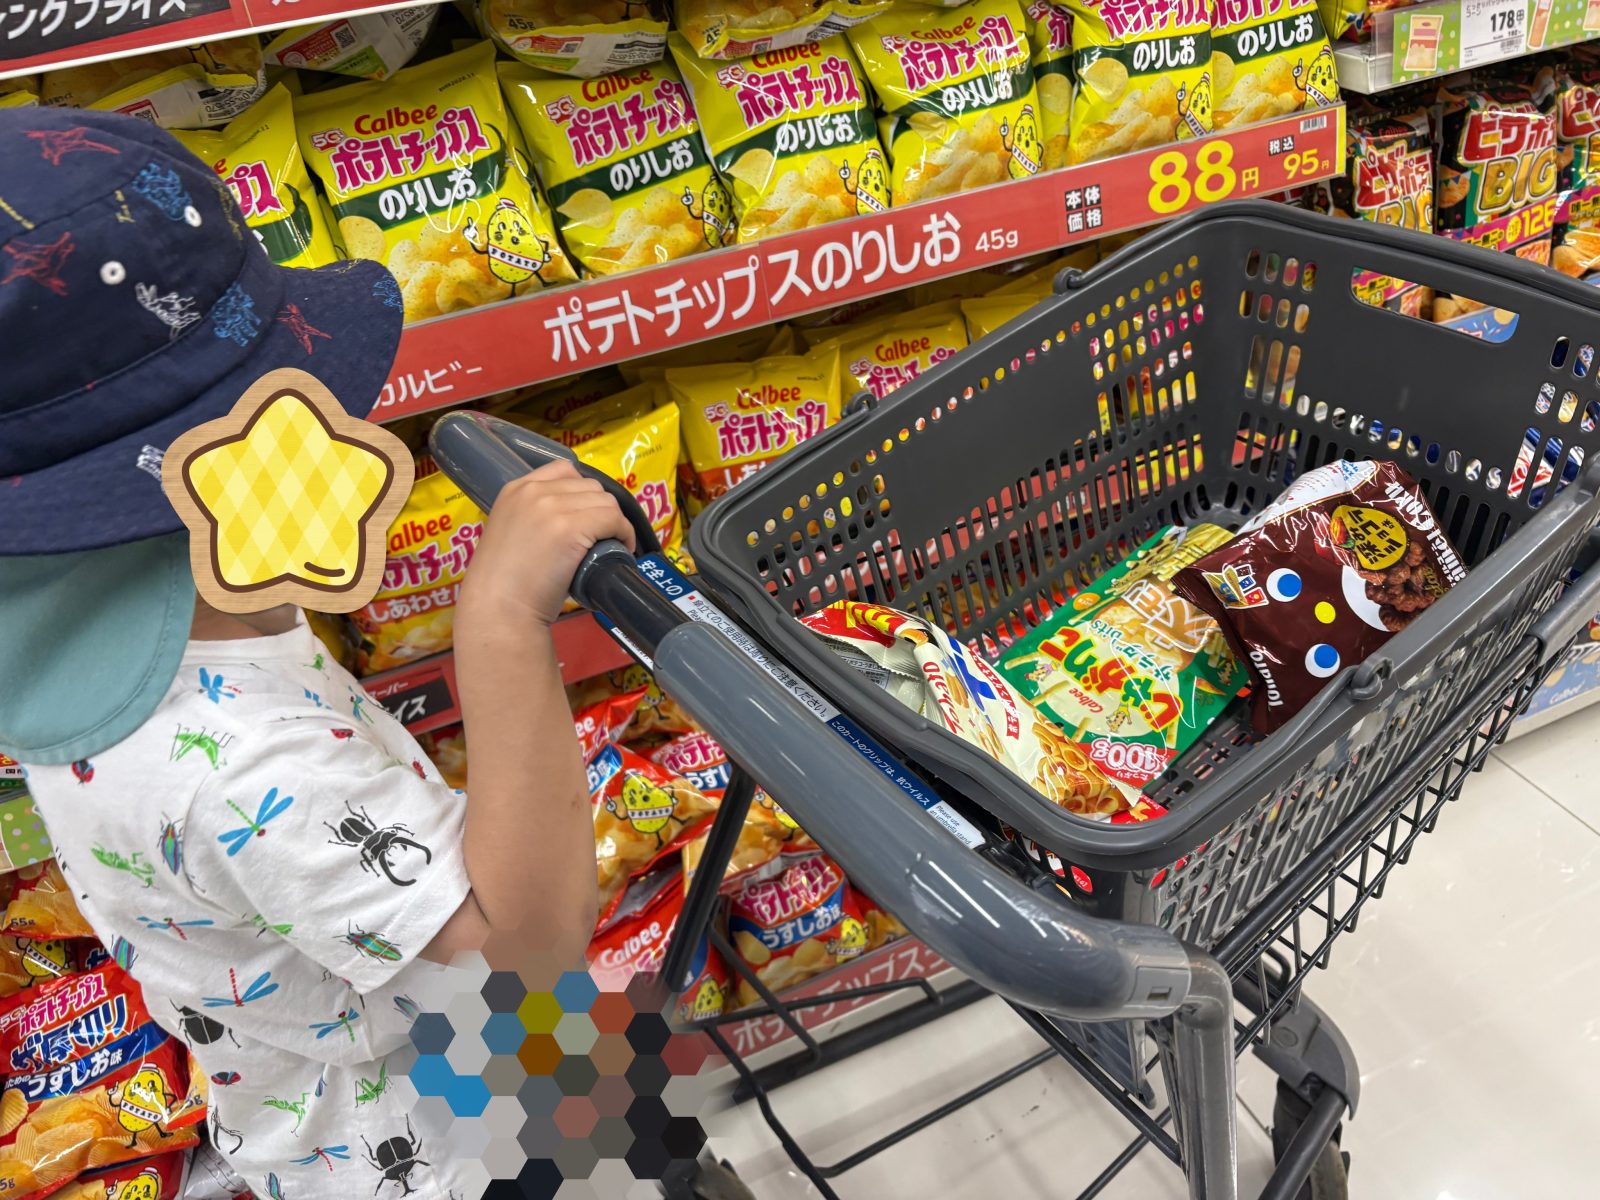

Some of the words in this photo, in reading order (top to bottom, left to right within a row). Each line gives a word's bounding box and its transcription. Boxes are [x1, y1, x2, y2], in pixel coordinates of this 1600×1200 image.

[706, 24, 722, 46] 45
[911, 16, 976, 41] Calbee
[1237, 13, 1314, 57] のりしお
[900, 15, 1020, 93] ポテトチップス
[1132, 36, 1196, 72] のりしお
[736, 56, 862, 130] ポテトチップス
[943, 69, 1014, 112] のりしお
[355, 104, 438, 136] Calbee
[566, 79, 698, 168] ポテトチップス
[776, 114, 856, 153] のりしお
[330, 105, 491, 193] ポテトチップス
[1269, 135, 1295, 155] 税込
[610, 139, 694, 192] のりしお
[1477, 144, 1556, 212] BIG
[378, 168, 478, 221] のりしお
[1066, 186, 1101, 210] 本体
[1067, 208, 1102, 233] 価格
[491, 247, 538, 270] POTATO
[543, 212, 962, 364] ポテトチップスのりしお
[974, 227, 1019, 254] 45g
[875, 337, 931, 362] Calbee
[737, 385, 801, 409] Calbee
[389, 514, 453, 552] albee
[637, 559, 683, 596] 安全上の
[369, 583, 461, 622] しあわせ
[1037, 626, 1184, 733] じゃがりこ
[1068, 687, 1104, 714] Calbee
[1090, 738, 1160, 774] 100g
[936, 805, 952, 820] Please
[949, 816, 961, 827] use
[955, 831, 972, 846] stand
[19, 973, 107, 1039] ポテトチップス
[10, 994, 127, 1072] ザ厚切り
[28, 1048, 123, 1097] うすしお味
[121, 1100, 161, 1121] POTATO
